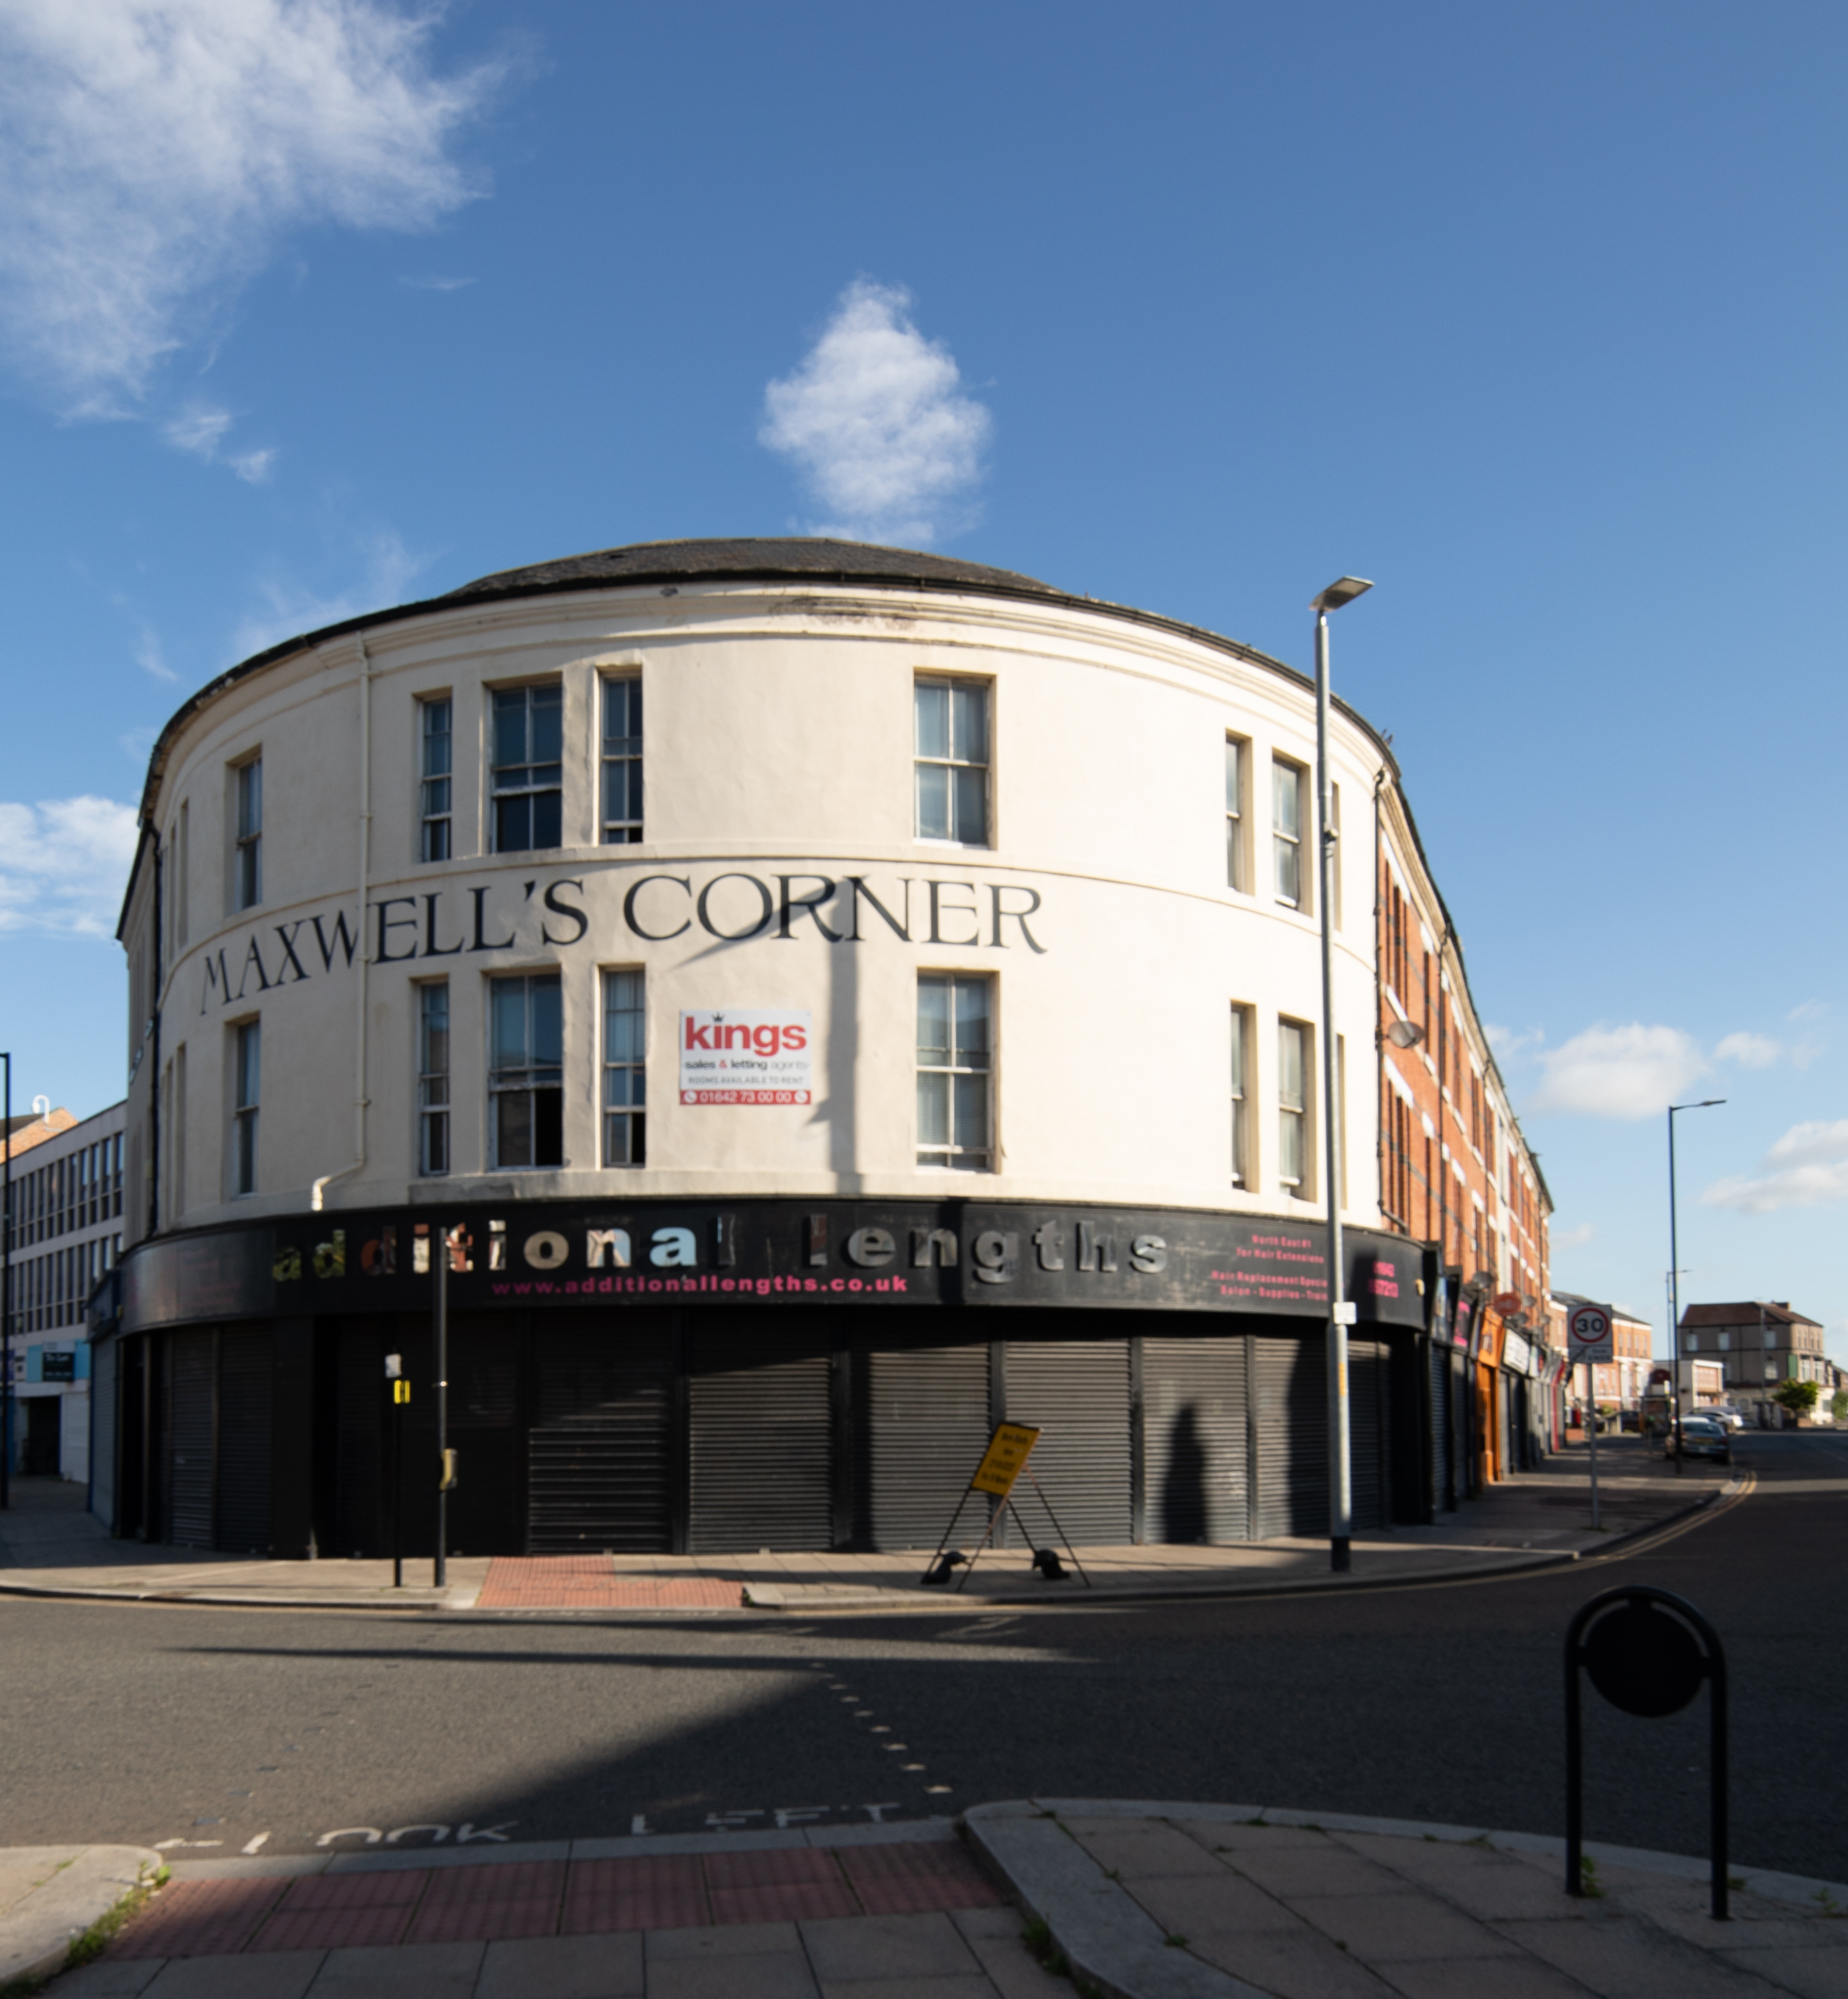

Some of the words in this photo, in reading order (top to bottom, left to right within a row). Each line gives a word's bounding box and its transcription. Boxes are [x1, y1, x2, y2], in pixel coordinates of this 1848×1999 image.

[200, 879, 589, 1016] MAXWELL'S
[623, 873, 1048, 954] CORNER
[685, 1016, 808, 1057] kings
[685, 1059, 716, 1070] sales
[719, 1060, 728, 1069] &
[731, 1059, 768, 1071] letting
[771, 1060, 808, 1071] agents
[720, 1076, 768, 1085] AVAILABLE
[769, 1076, 780, 1084] TO
[782, 1076, 804, 1084] RENT
[699, 1091, 738, 1103] 01642
[740, 1091, 756, 1103] 73
[757, 1091, 774, 1103] 00
[775, 1091, 792, 1103] 00
[1251, 1234, 1279, 1246] North
[1280, 1236, 1301, 1248] East
[272, 1215, 736, 1282] additional
[809, 1215, 1168, 1284] lengths
[1236, 1246, 1252, 1257] for
[1254, 1249, 1275, 1259] Hair
[1276, 1250, 1324, 1264] Extensions
[491, 1275, 908, 1296] www.additionallengths.co.uk
[1211, 1270, 1235, 1281] Hair
[1237, 1271, 1298, 1285] Replacement
[1299, 1276, 1328, 1287] Specia
[1220, 1285, 1251, 1296] Salon
[1258, 1286, 1300, 1300] Supplies
[1307, 1290, 1328, 1301] Train
[1577, 1317, 1603, 1332] 30
